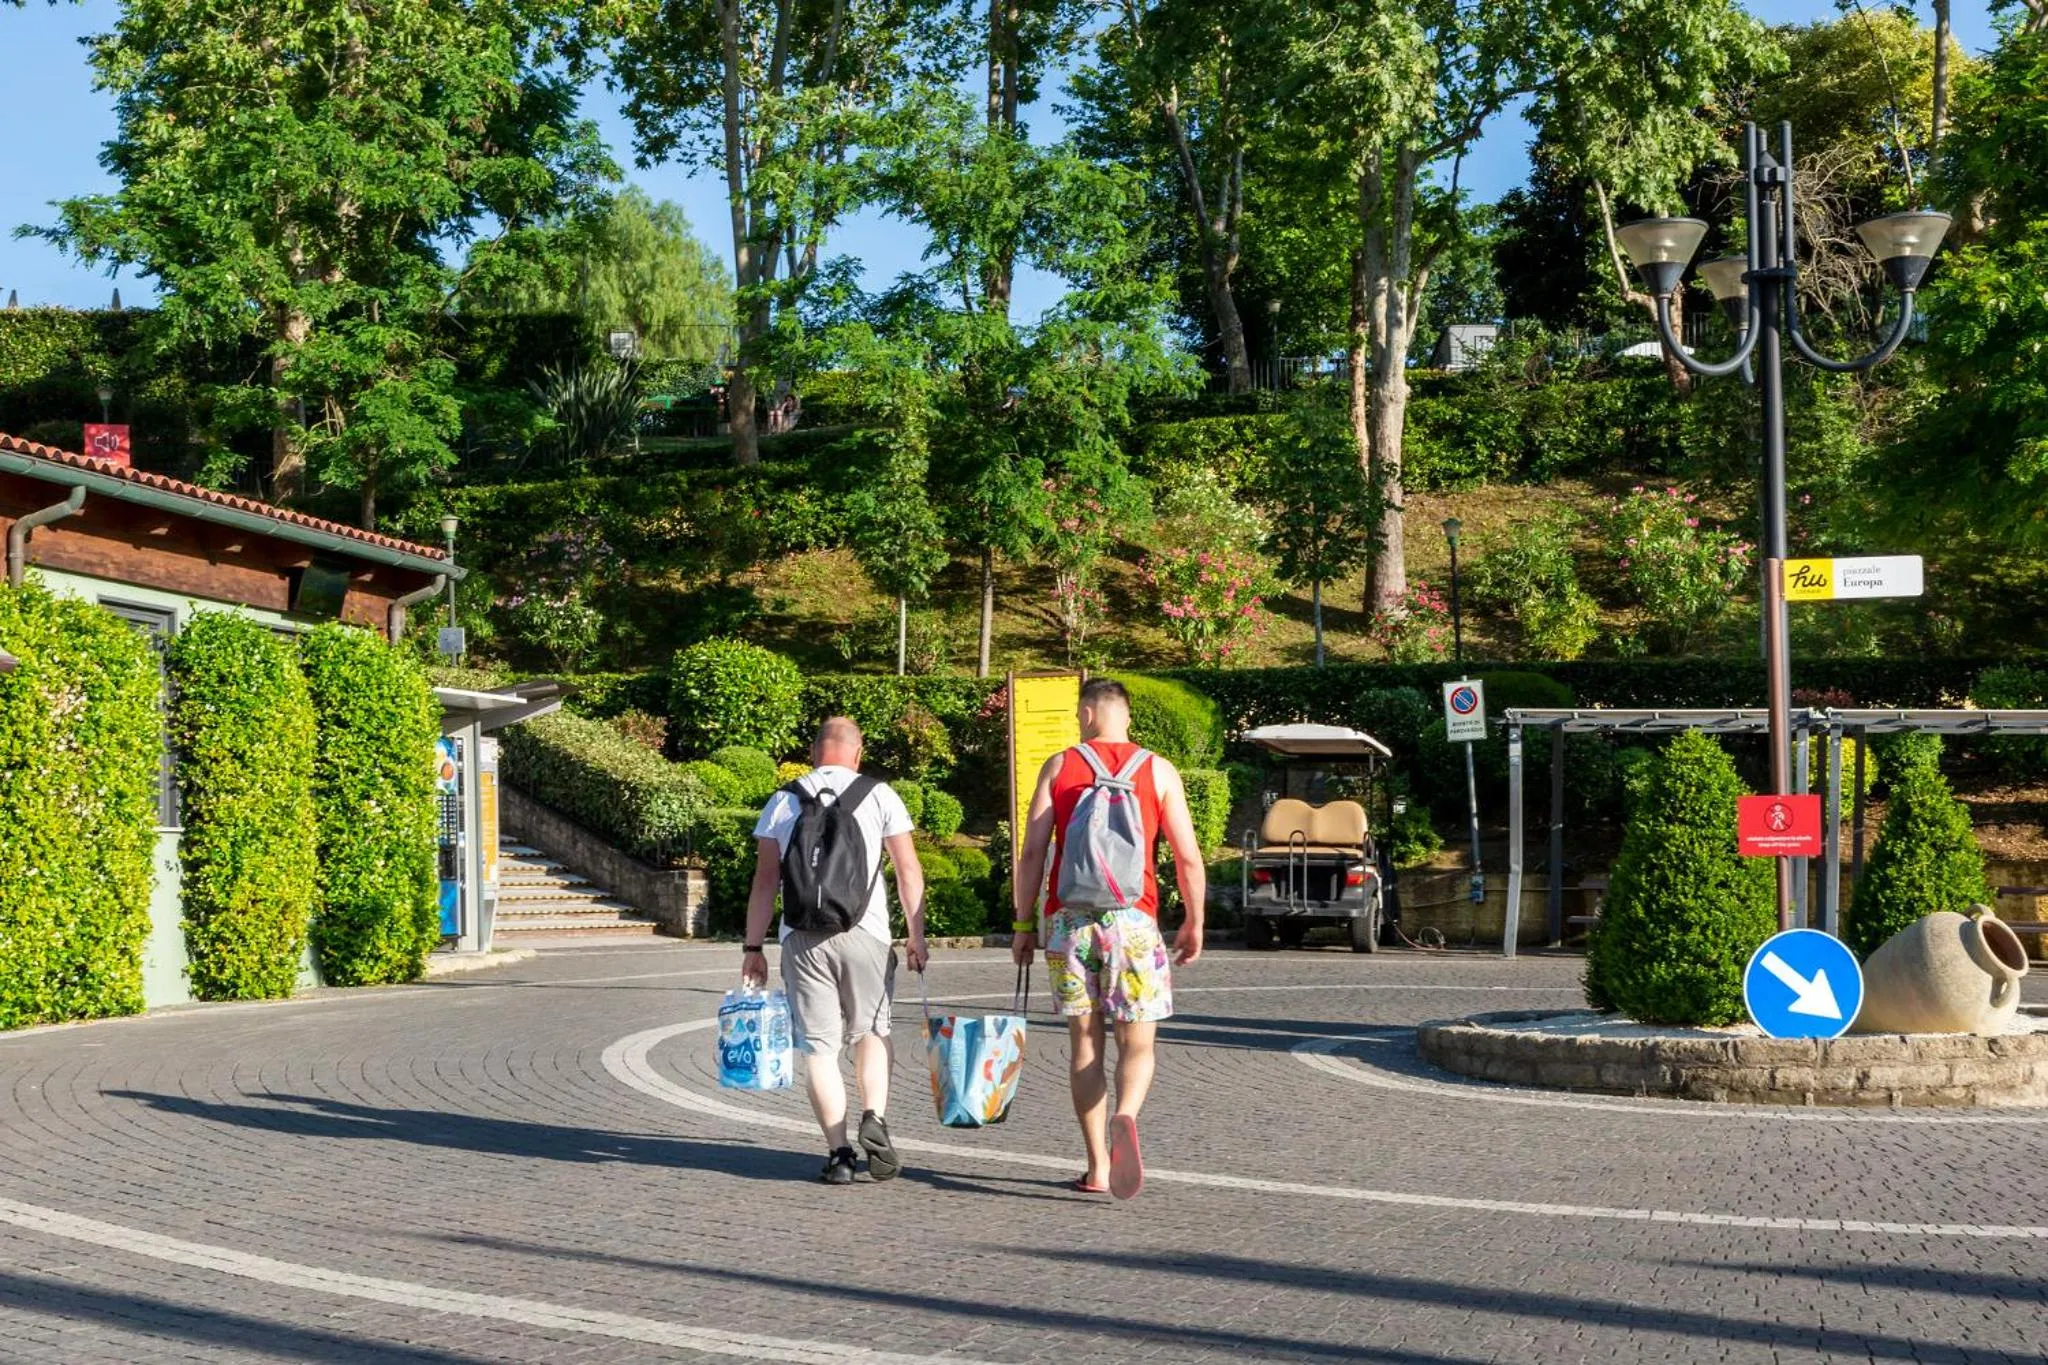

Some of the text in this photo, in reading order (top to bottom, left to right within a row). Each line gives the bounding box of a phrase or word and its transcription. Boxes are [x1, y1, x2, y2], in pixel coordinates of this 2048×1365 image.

[1843, 564, 1882, 576] piazzale
[1789, 565, 1828, 588] hu
[1843, 577, 1883, 589] Europa
